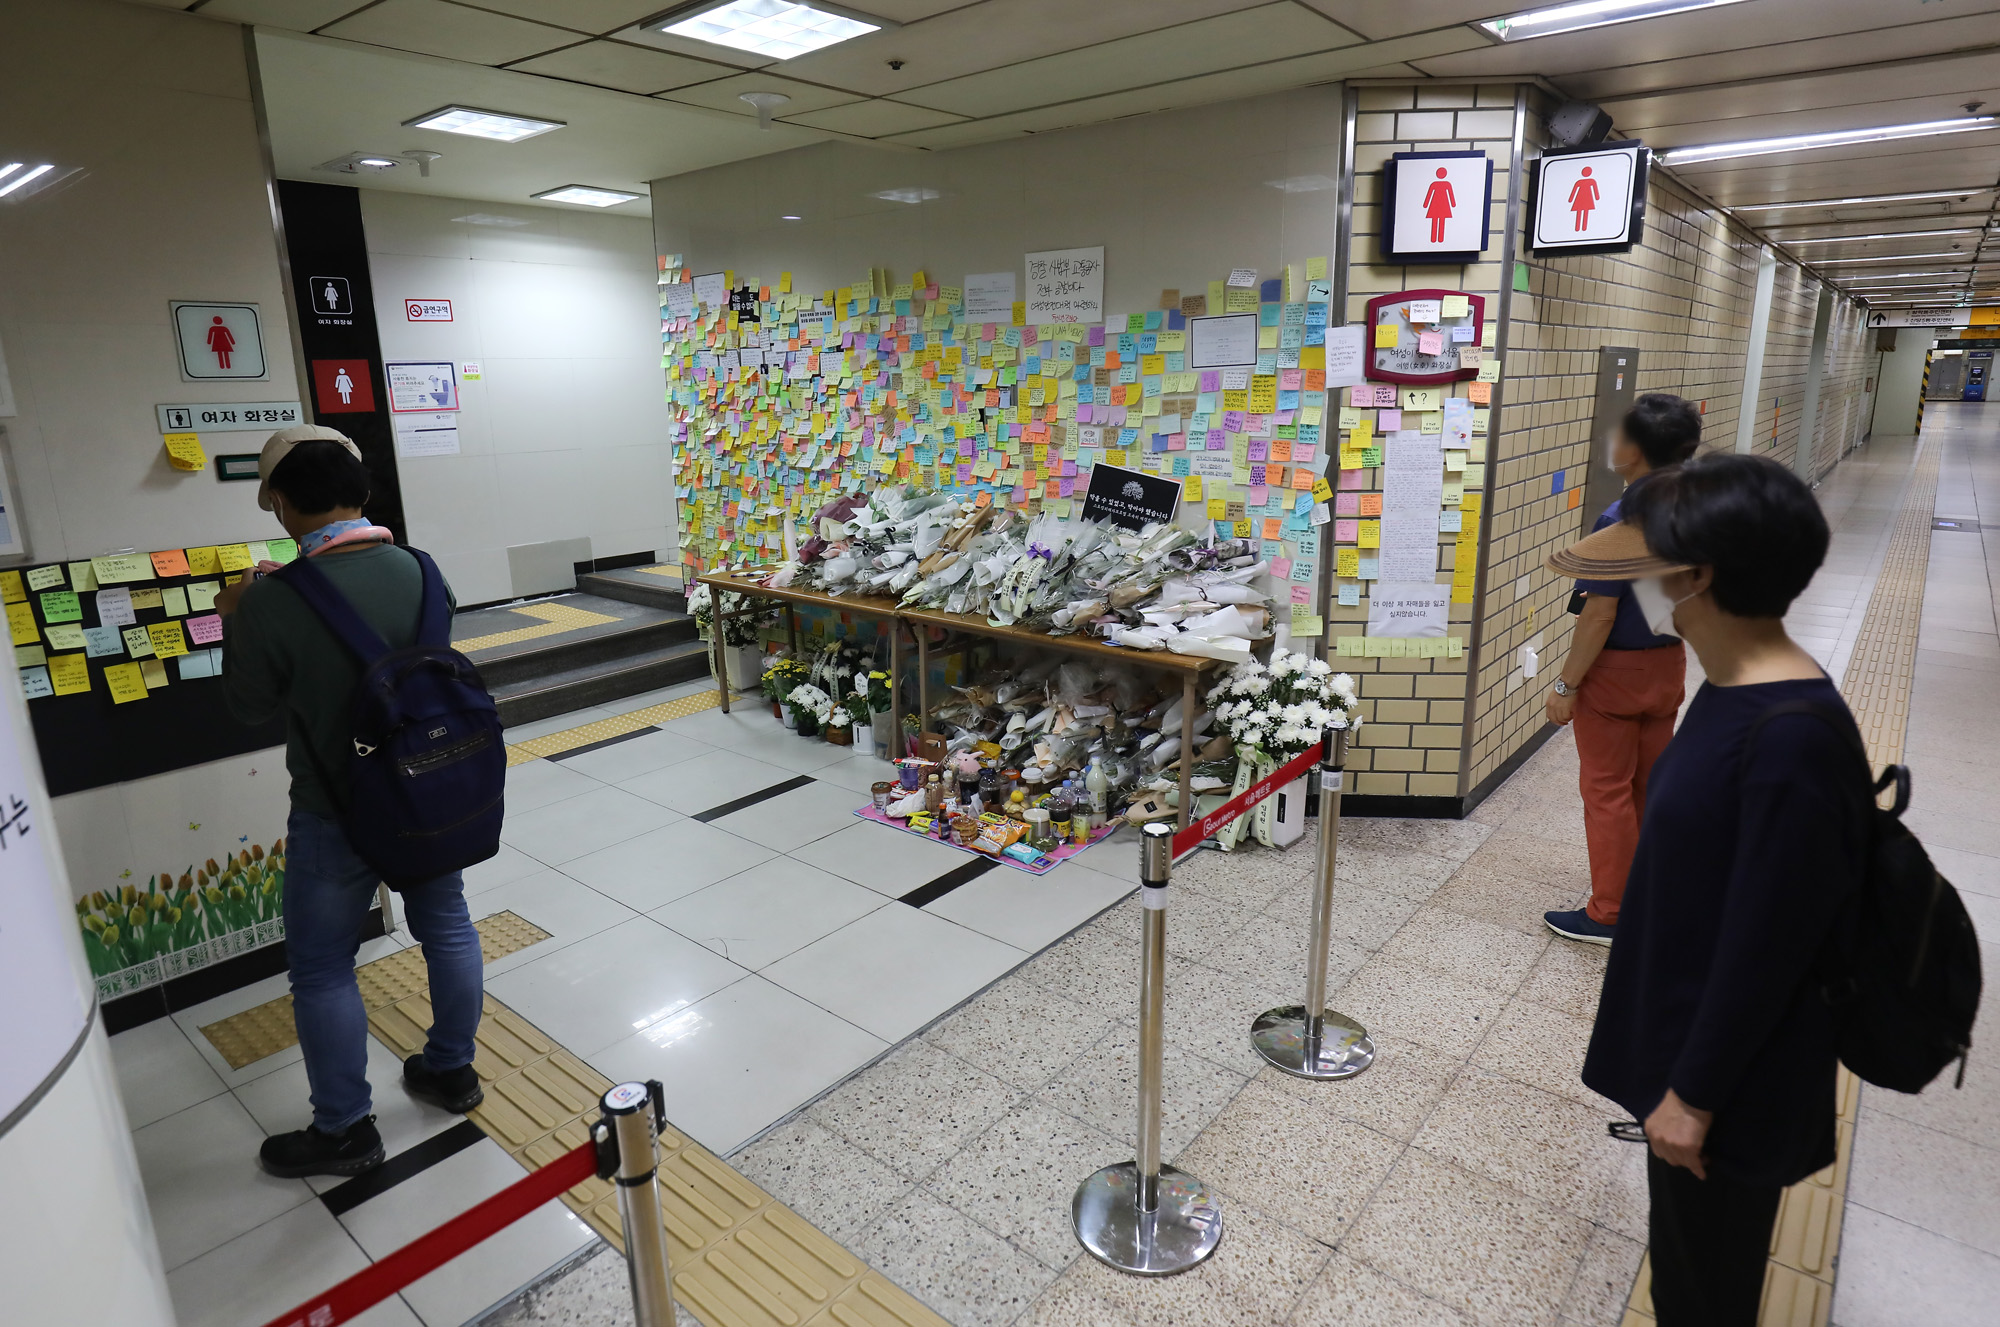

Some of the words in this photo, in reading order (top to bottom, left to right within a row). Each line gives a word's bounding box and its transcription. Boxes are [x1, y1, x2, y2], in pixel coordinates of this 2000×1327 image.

[1029, 260, 1047, 280] 경찰
[1049, 258, 1070, 278] 사법부
[1072, 259, 1100, 277] 교통공사
[1055, 281, 1084, 295] 공범이다
[423, 306, 448, 314] 금연구역
[1390, 348, 1413, 358] 여성이
[1442, 347, 1459, 358] 서울
[1432, 362, 1452, 370] 화장실
[202, 410, 237, 423] 여자
[244, 409, 295, 422] 화장실
[1090, 494, 1100, 502] 막을
[1108, 499, 1126, 509] 있었고,
[1128, 504, 1144, 513] 막아야
[1145, 508, 1168, 520] 했습니다
[1244, 782, 1271, 806] 서울메트로
[1206, 818, 1220, 834] Seoul
[1221, 810, 1236, 823] Metro
